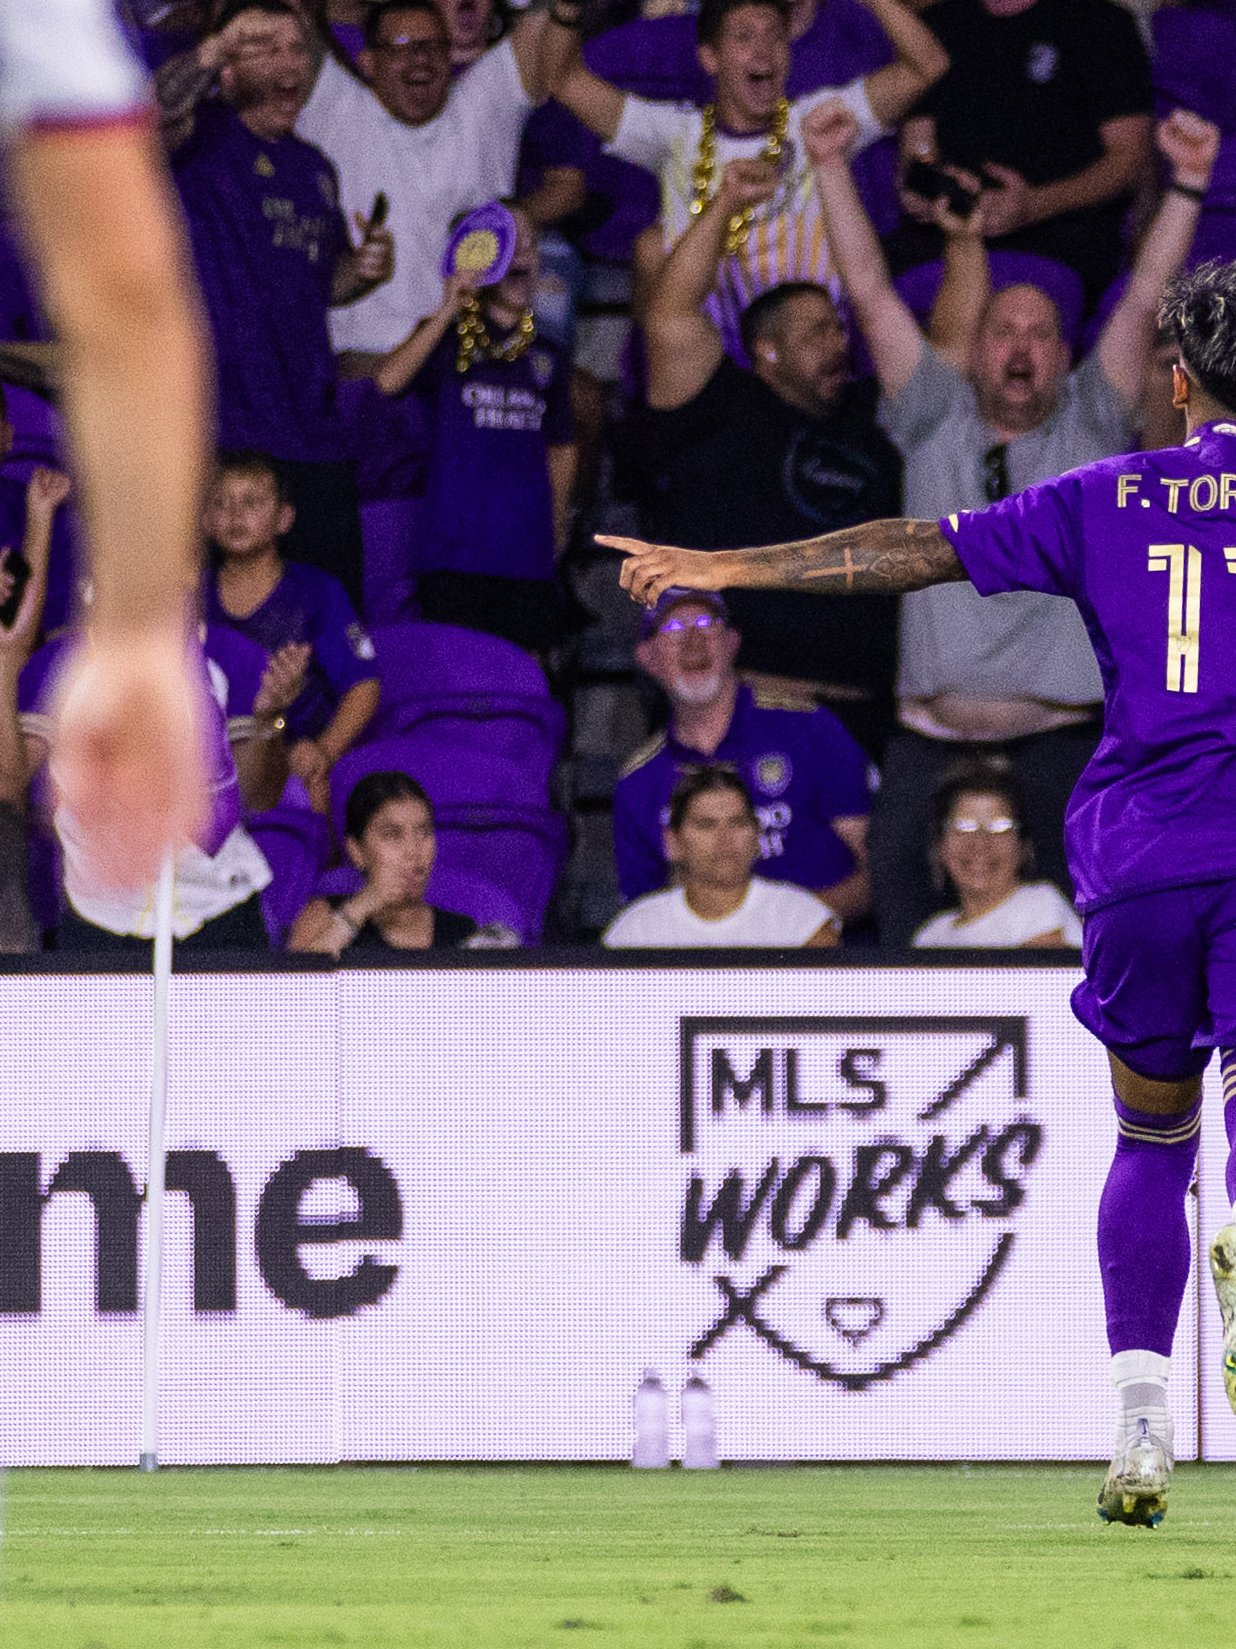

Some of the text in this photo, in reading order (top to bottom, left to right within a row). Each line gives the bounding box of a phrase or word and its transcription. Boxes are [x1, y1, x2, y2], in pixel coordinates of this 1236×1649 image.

[1117, 474, 1150, 508] F.
[711, 1048, 888, 1114] MLS
[0, 1146, 403, 1319] me
[680, 1123, 1042, 1262] WORKS
